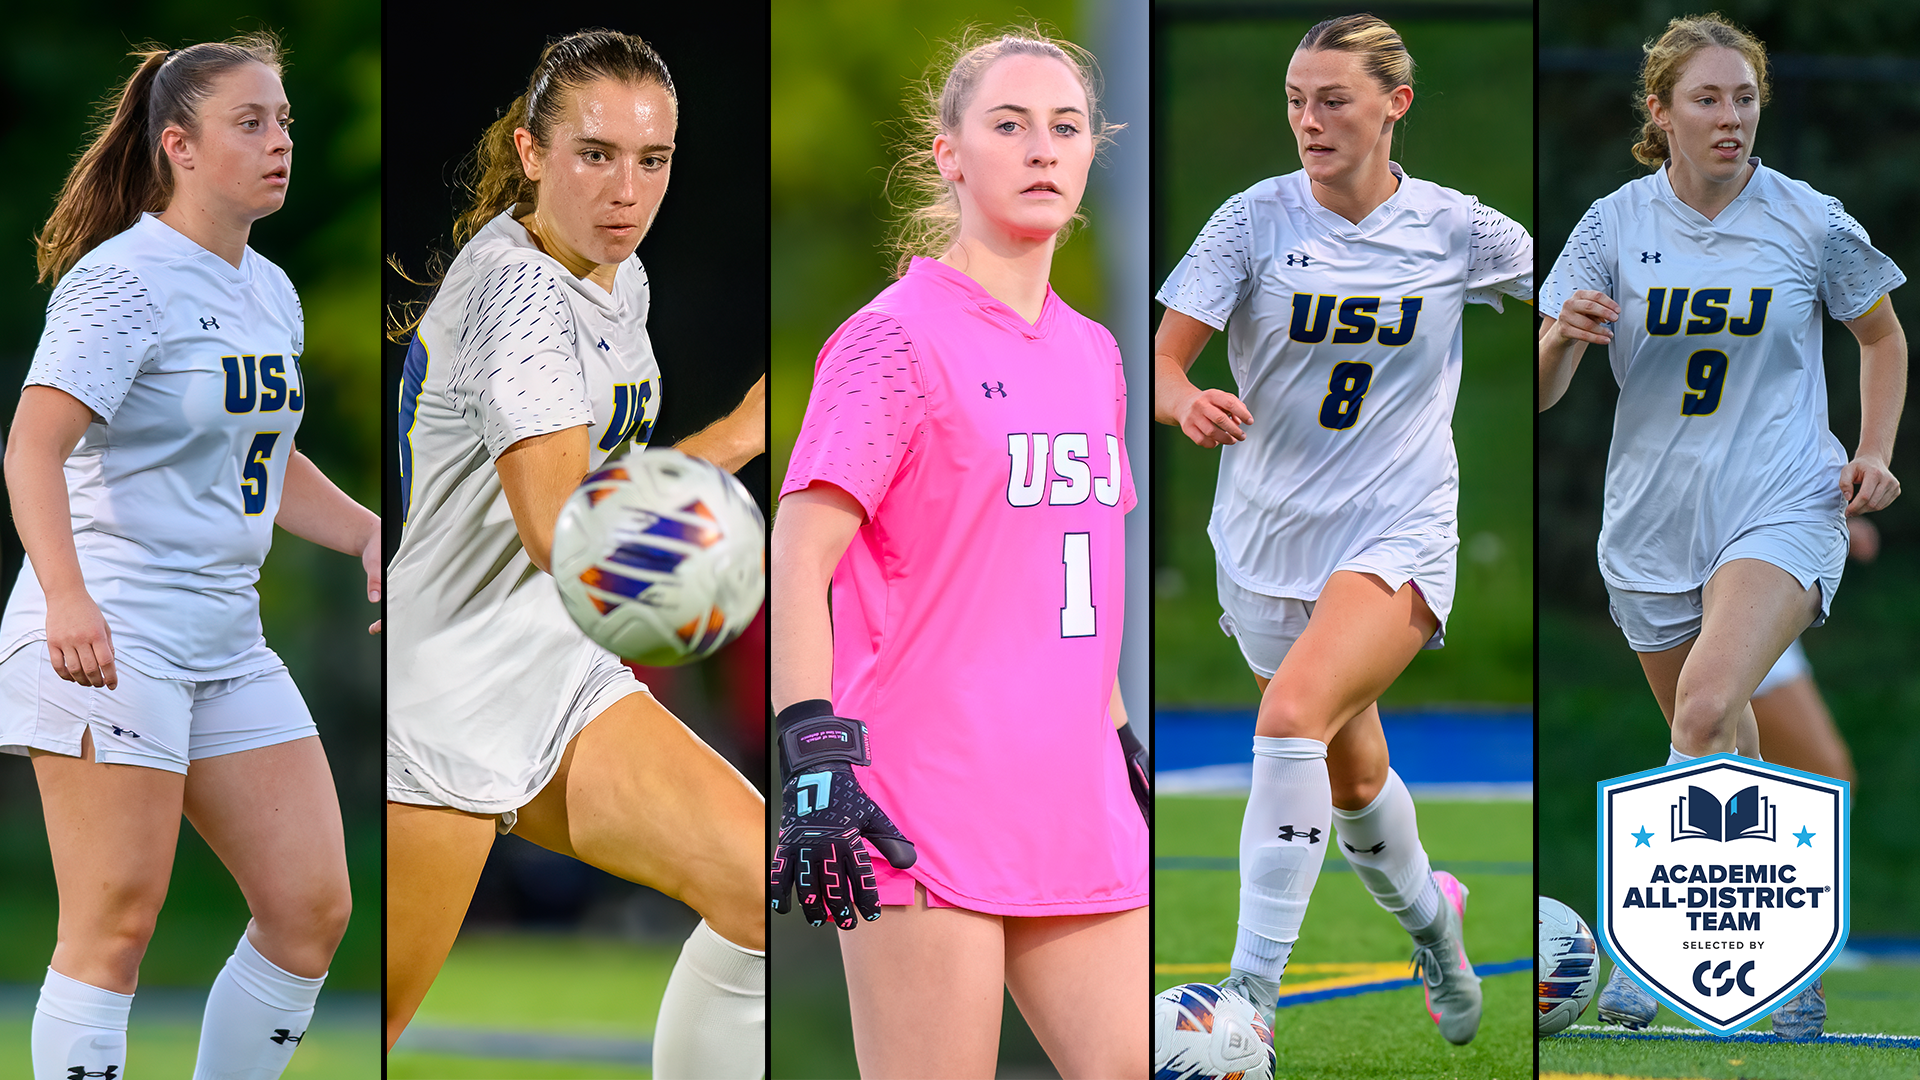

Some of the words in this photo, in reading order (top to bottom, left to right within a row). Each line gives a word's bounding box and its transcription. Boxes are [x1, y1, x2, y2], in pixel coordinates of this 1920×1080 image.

[1288, 292, 1424, 347] USJ
[1646, 287, 1773, 337] USJ
[1318, 360, 1374, 431] 8
[1680, 348, 1730, 417] 9
[240, 431, 282, 516] 5
[1007, 433, 1121, 507] USJ
[1060, 532, 1096, 639] 1
